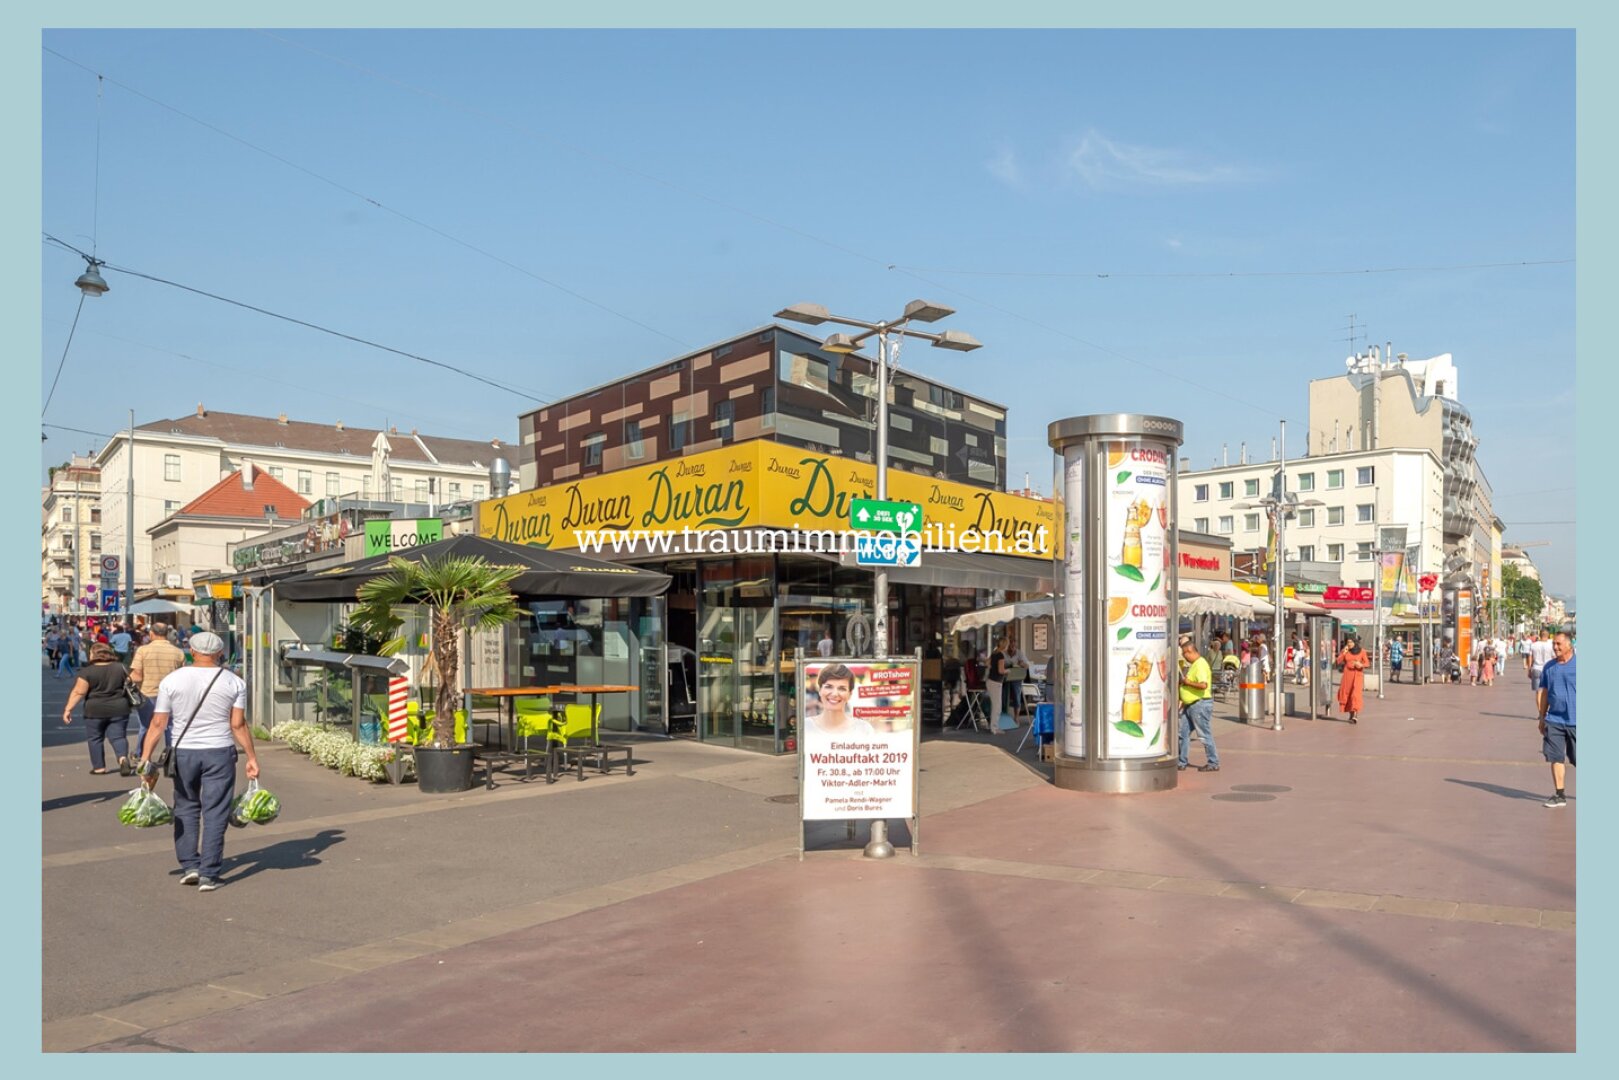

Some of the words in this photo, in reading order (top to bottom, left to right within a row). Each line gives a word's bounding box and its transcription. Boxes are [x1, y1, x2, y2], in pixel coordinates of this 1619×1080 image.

[675, 460, 705, 477] Duran
[767, 457, 800, 479] Duran
[642, 465, 749, 528] Duran
[928, 485, 964, 511] Duran
[561, 482, 634, 530] Duran
[491, 500, 553, 548] Duran
[968, 493, 1047, 555] Duran
[370, 533, 438, 547] WELCOME
[860, 541, 881, 559] WC
[831, 742, 870, 751] Einladung
[810, 753, 879, 764] Wahlauftakt
[882, 752, 908, 763] 2019
[817, 768, 828, 776] Fr.
[853, 768, 862, 776] ab
[886, 767, 901, 775] Uhr
[821, 779, 896, 787] Viktor-Adler-Markt
